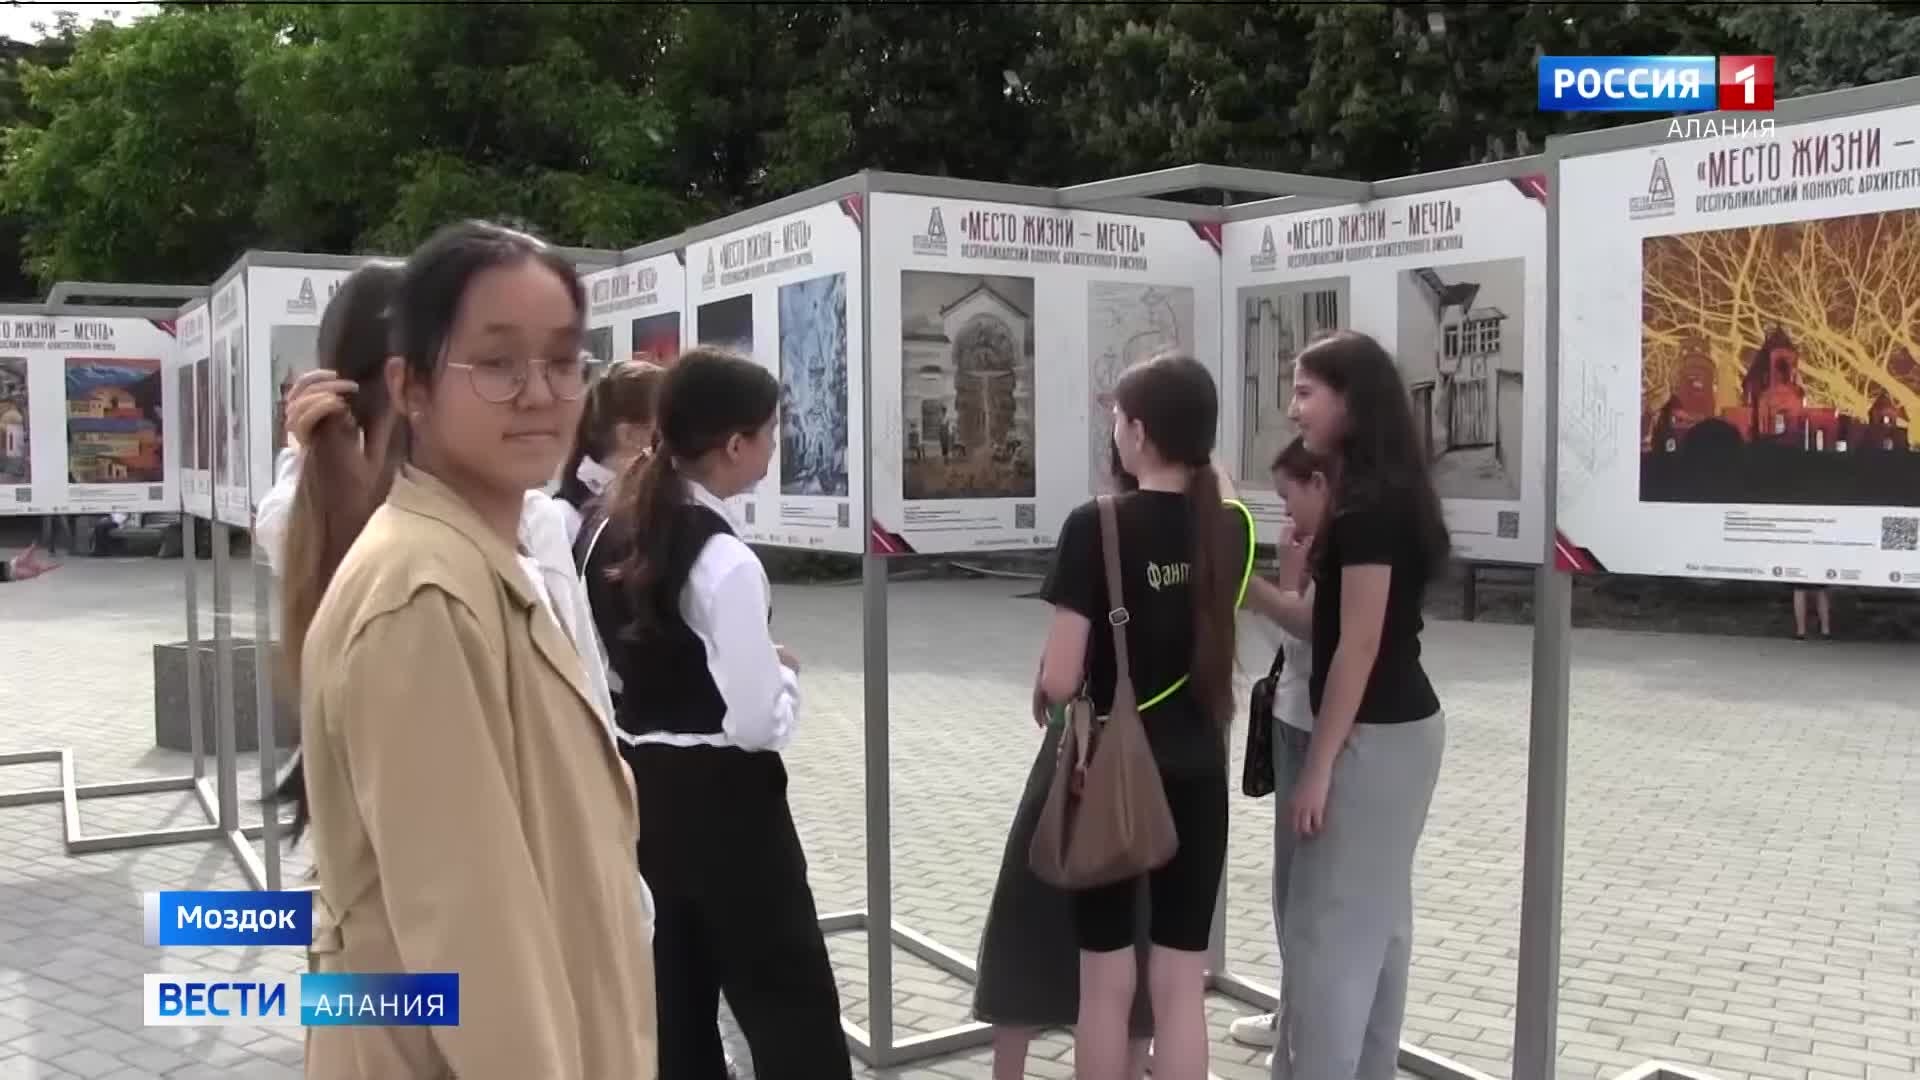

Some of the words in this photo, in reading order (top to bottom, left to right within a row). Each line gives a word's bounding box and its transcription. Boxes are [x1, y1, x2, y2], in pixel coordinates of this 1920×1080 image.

[1697, 142, 1780, 188] «МЕСТО
[1792, 128, 1880, 177] ЖИЗНИ
[1802, 176, 1855, 201] КОНКУРС
[1023, 215, 1074, 248] ЖИЗНИ
[1338, 208, 1386, 244] ЖИЗНИ
[15, 321, 56, 340] ЖИЗНИ
